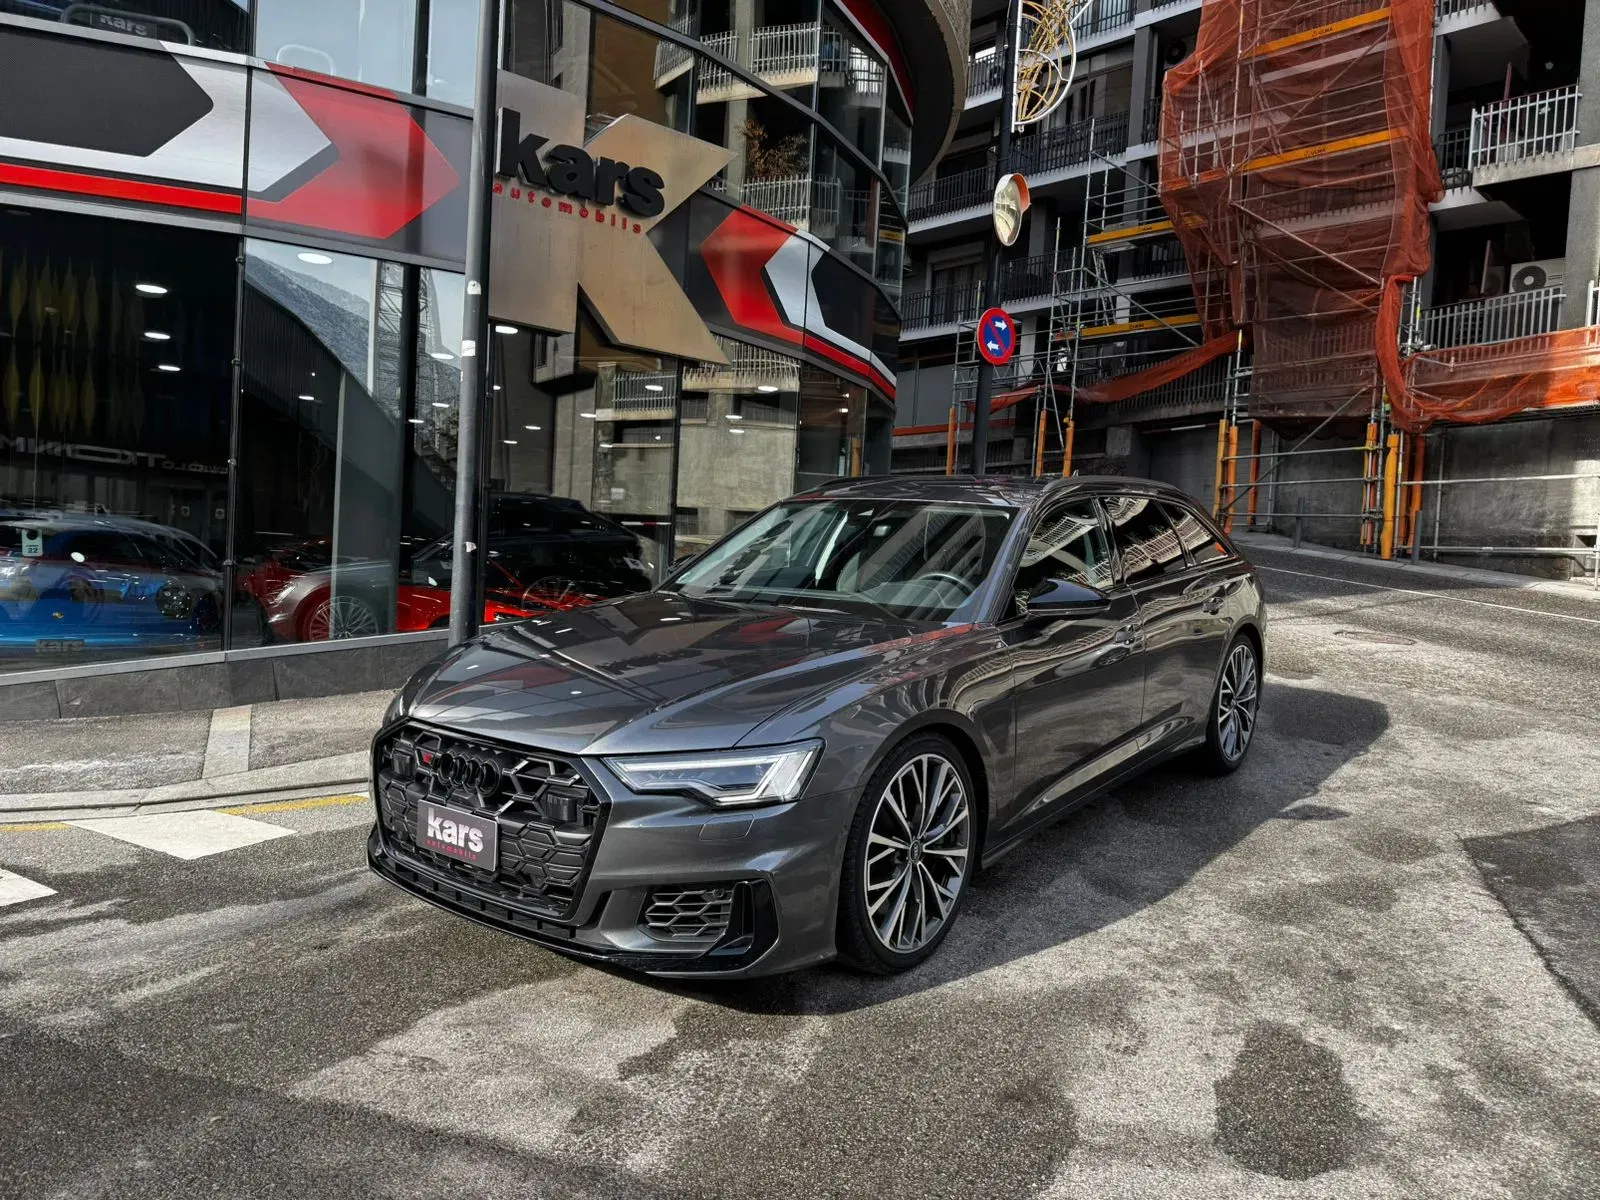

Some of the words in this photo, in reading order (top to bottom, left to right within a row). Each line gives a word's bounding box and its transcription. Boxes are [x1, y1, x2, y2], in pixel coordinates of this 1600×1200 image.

[495, 106, 665, 217] kars
[492, 182, 642, 234] automobils
[427, 806, 484, 853] kars
